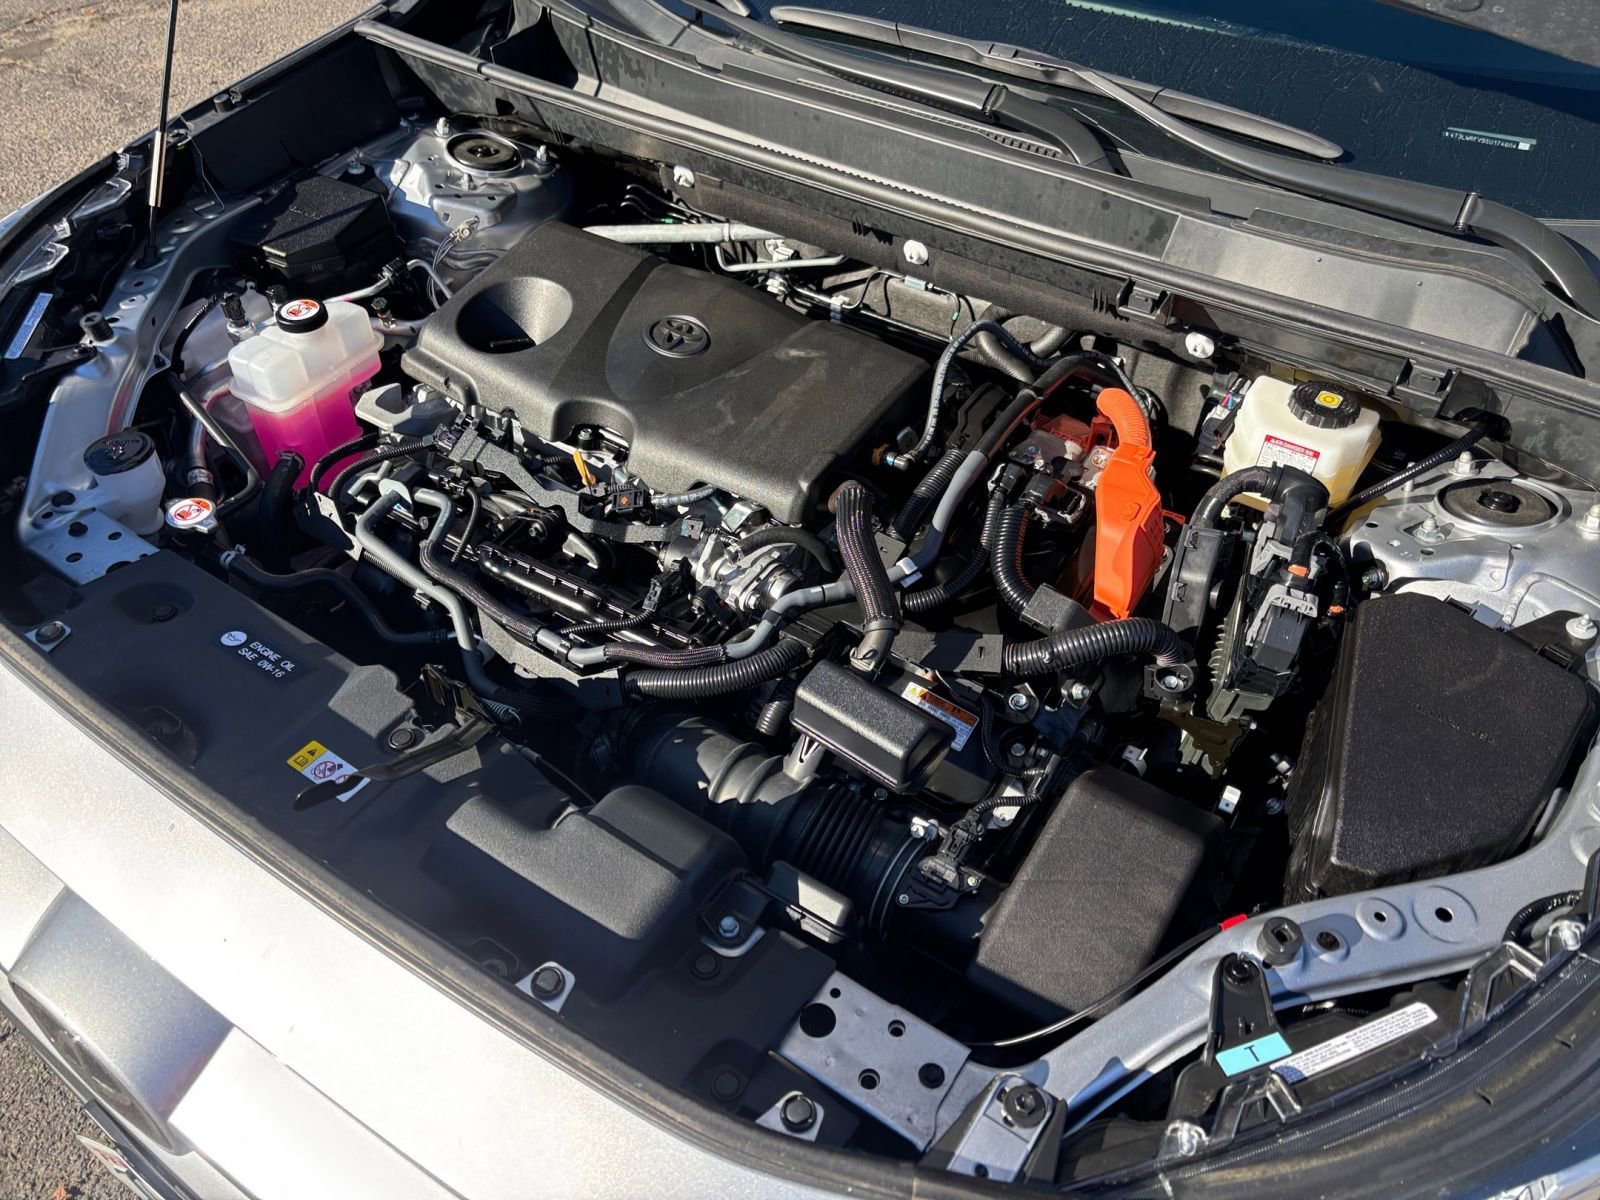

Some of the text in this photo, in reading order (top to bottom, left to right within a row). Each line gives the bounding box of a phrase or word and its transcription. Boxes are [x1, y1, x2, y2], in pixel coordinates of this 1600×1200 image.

[238, 647, 285, 678] SAE 0W-16
[249, 641, 295, 672] ENGINE OIL
[1244, 1044, 1260, 1062] T
